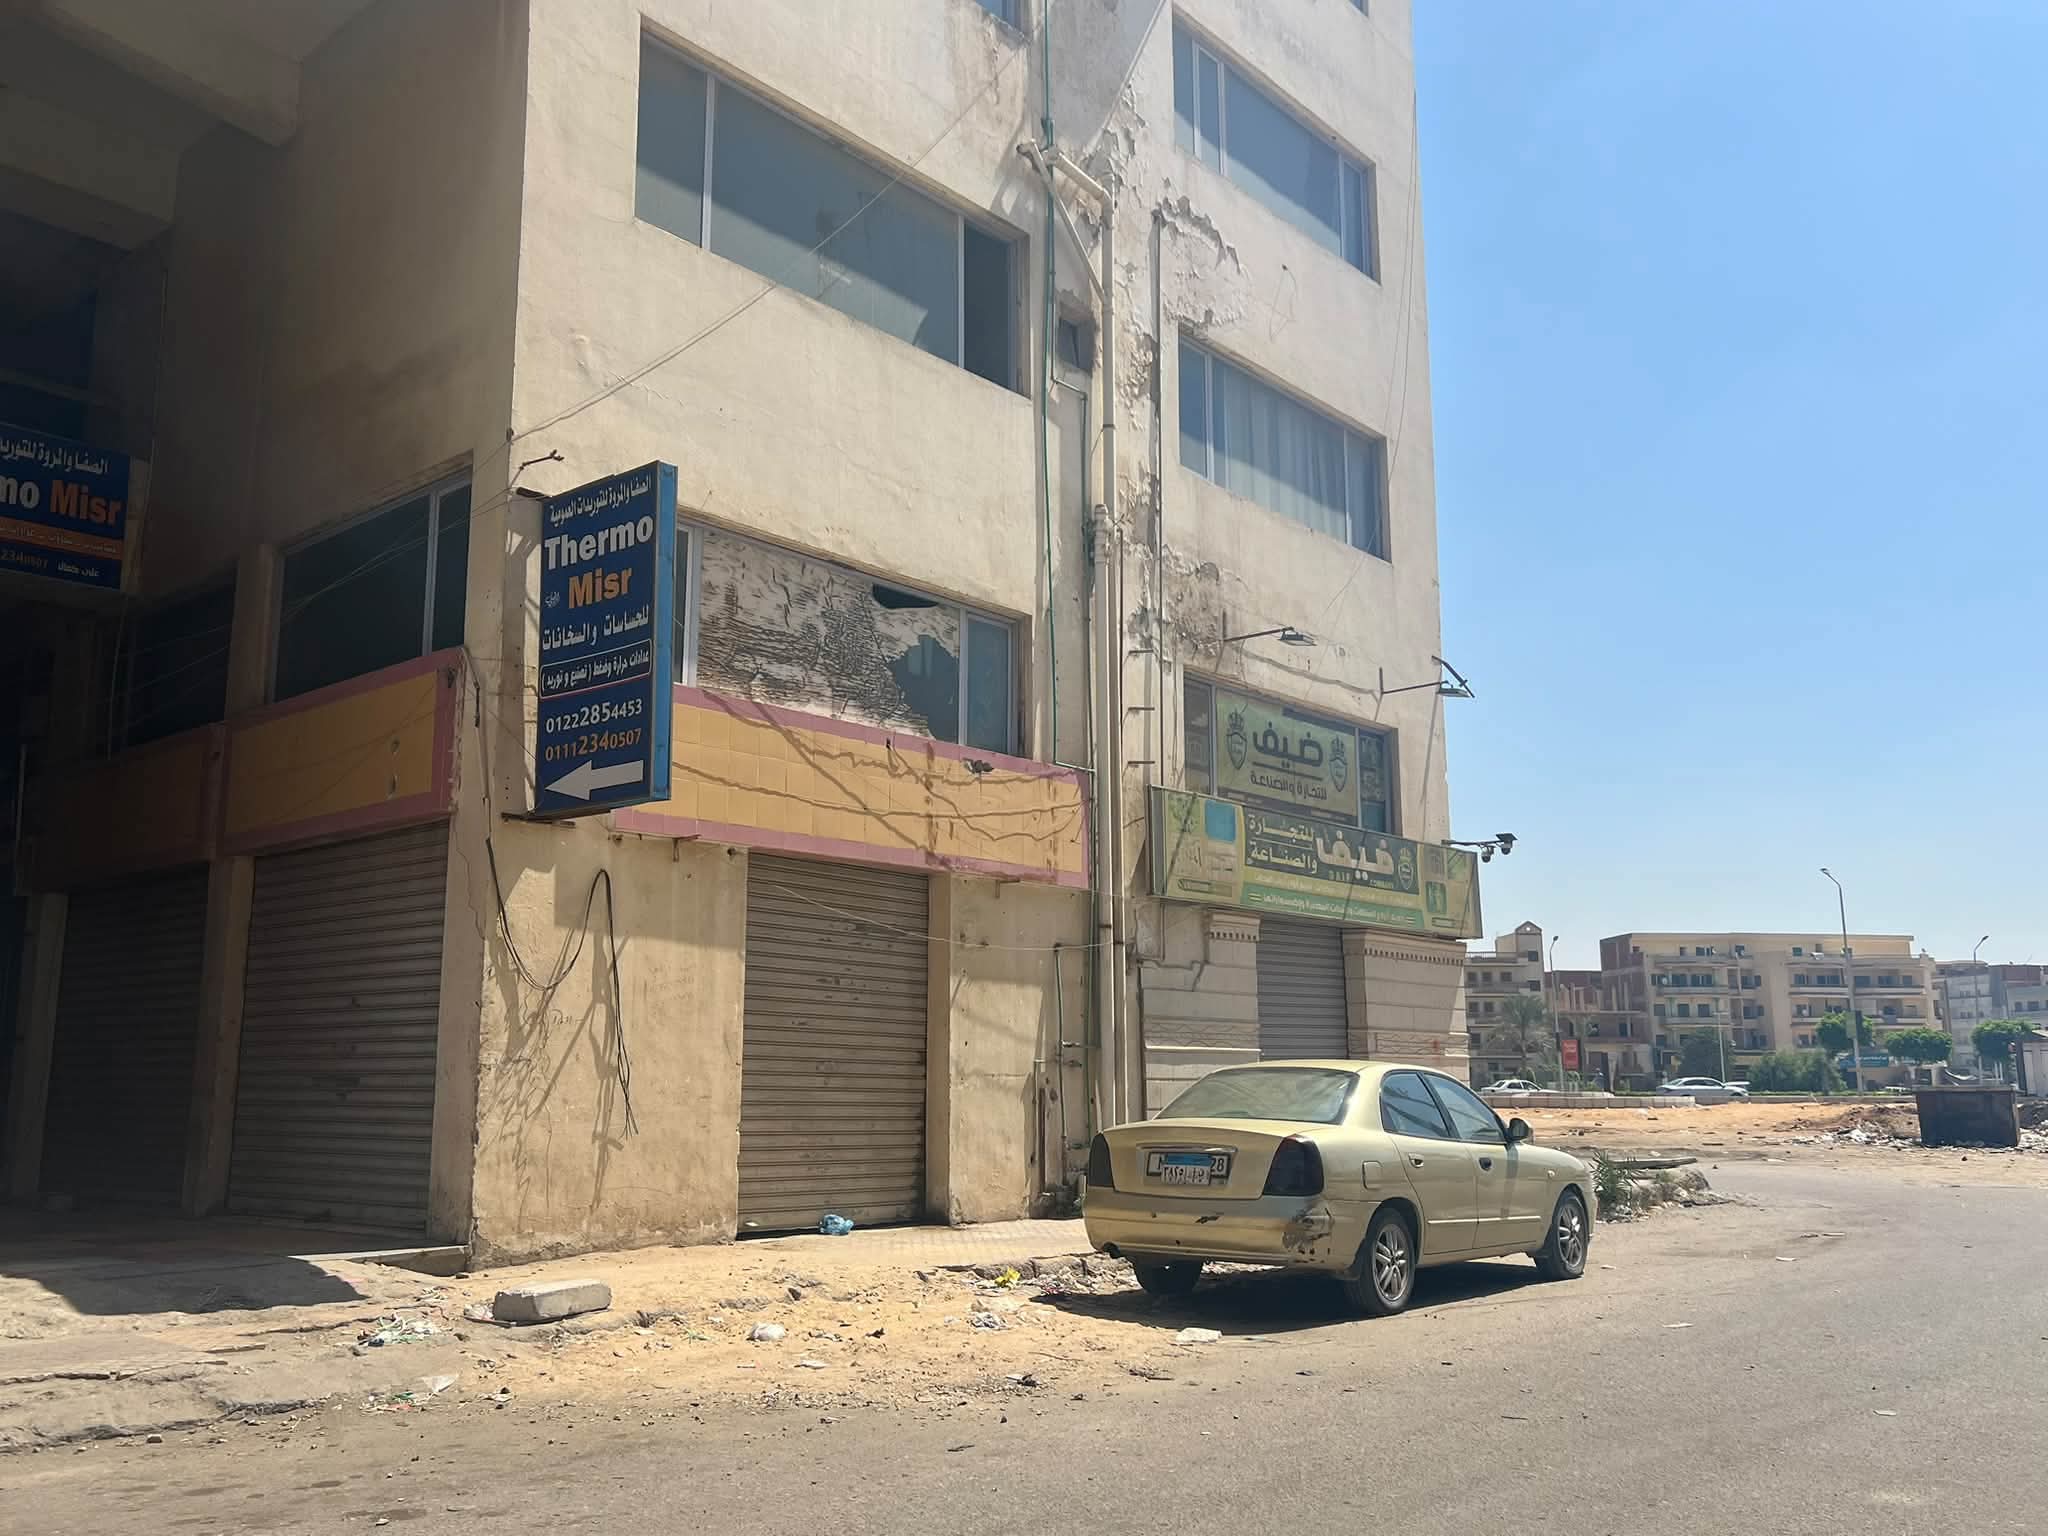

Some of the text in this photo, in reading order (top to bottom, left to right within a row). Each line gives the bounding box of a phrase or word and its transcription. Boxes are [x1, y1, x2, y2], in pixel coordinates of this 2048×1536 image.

[75, 451, 109, 475] الصفا
[609, 482, 630, 508] والمروة
[630, 472, 651, 497] الصفا
[50, 479, 122, 527] Misr
[544, 515, 654, 571] Thermo
[568, 567, 633, 609] Misr
[603, 603, 649, 637] للحساسات
[545, 698, 643, 734] 01222854453
[544, 727, 642, 761] 01112340507
[1252, 720, 1324, 769] ضيف
